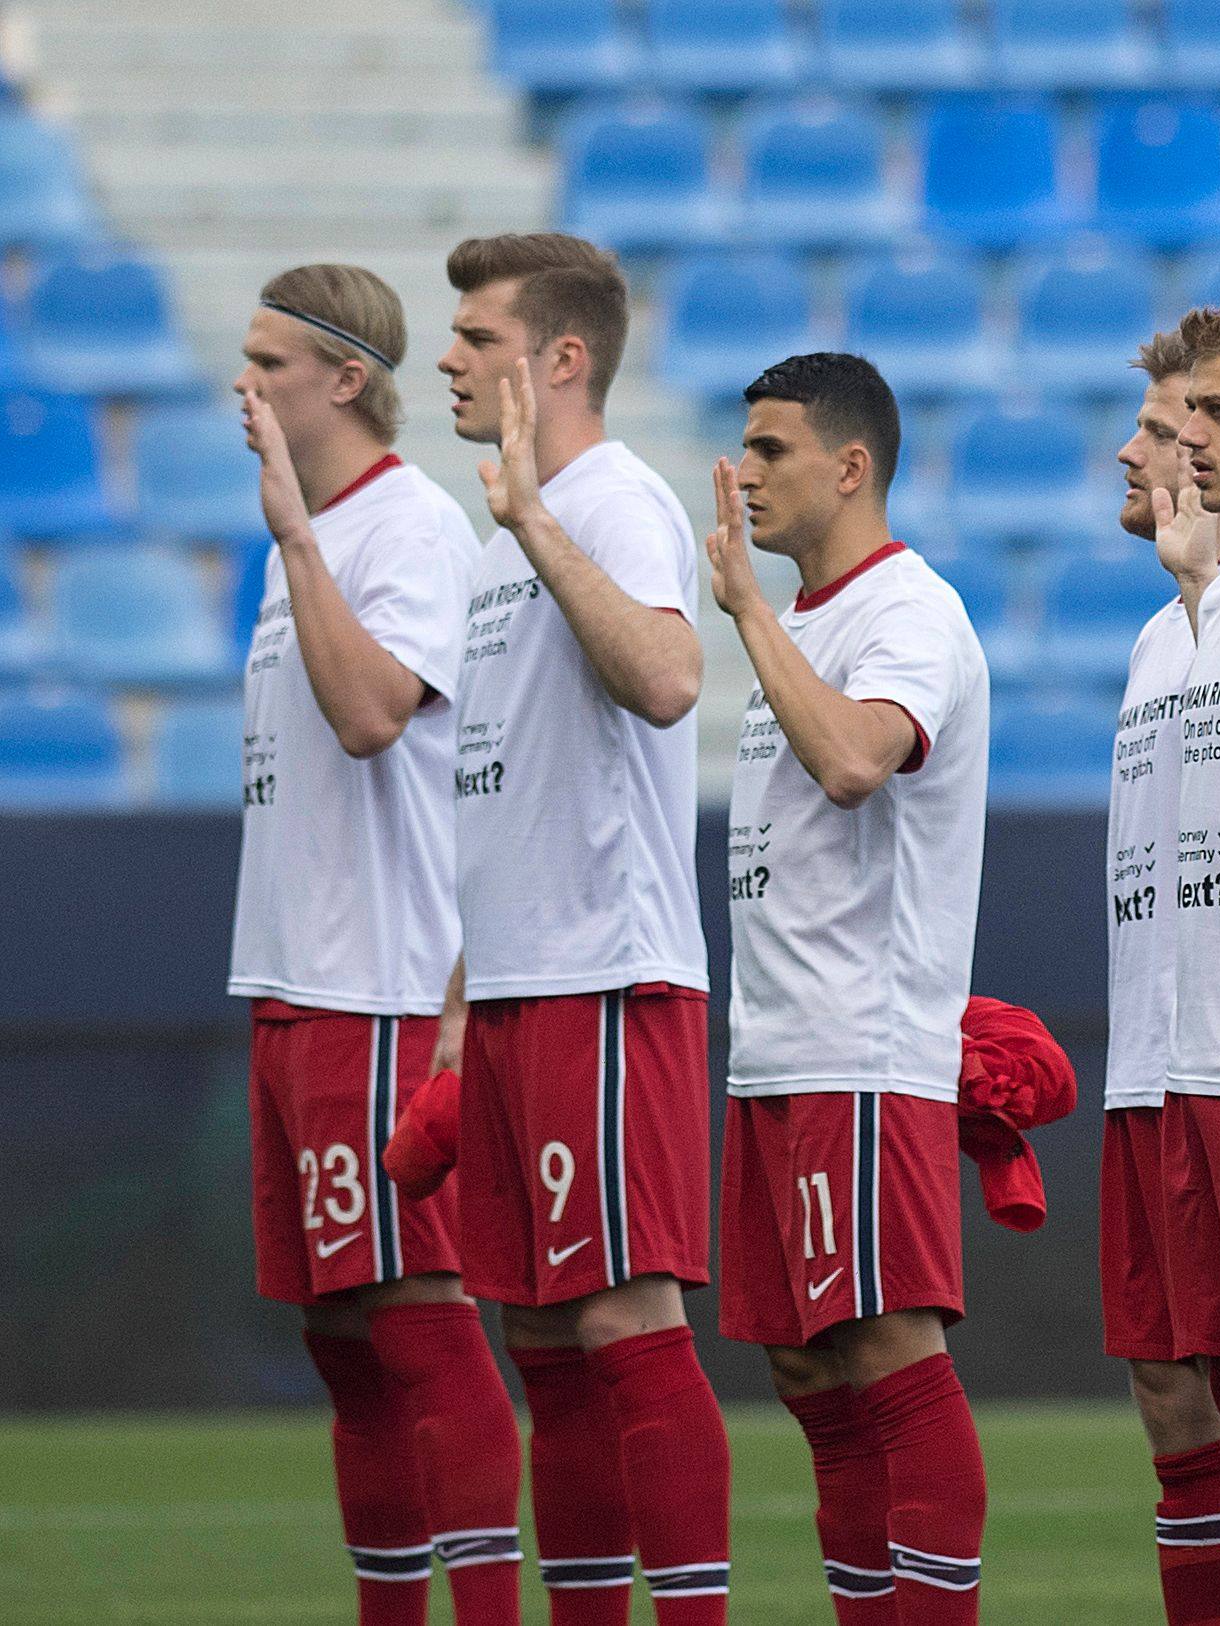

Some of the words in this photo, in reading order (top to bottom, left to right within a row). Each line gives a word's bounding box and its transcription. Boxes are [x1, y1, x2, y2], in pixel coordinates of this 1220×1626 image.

[1184, 718, 1196, 740] On
[1197, 714, 1214, 738] and
[455, 761, 504, 800] Next?
[1177, 846, 1215, 864] ermany
[732, 865, 770, 900] ext?
[1114, 886, 1156, 928] Nxt?
[299, 1143, 366, 1230] 23
[539, 1140, 576, 1223] 9
[798, 1172, 837, 1260] 11
